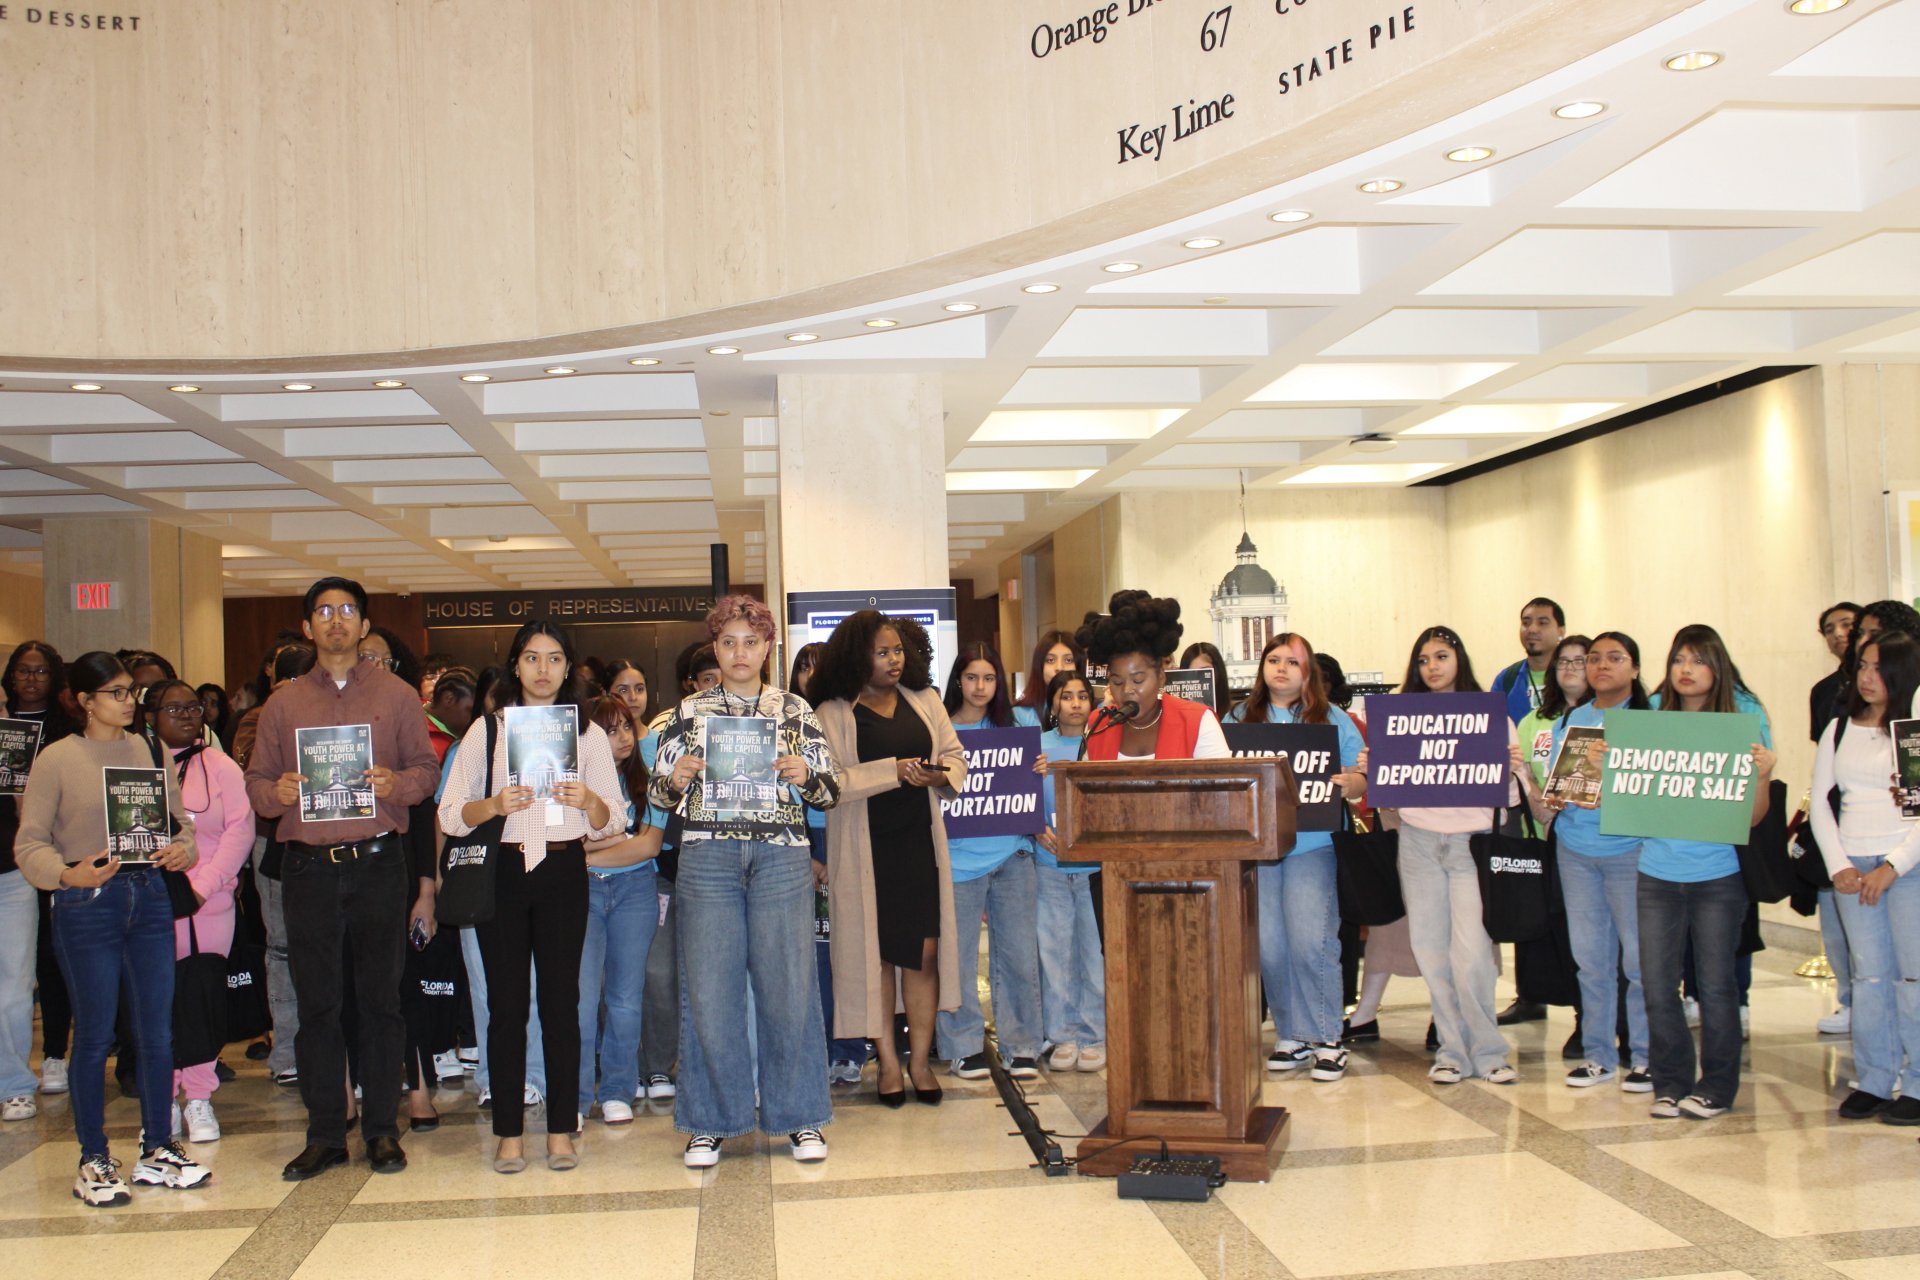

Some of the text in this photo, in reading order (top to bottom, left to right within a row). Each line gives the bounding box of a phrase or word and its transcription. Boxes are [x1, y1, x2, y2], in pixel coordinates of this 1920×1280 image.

[26, 7, 140, 31] DESSERT
[1200, 6, 1232, 52] 67
[1031, 2, 1119, 58] Orange
[1117, 6, 1415, 164] Key Lime STATE PIE
[77, 583, 111, 609] EXIT
[427, 595, 715, 618] HOUSE OF REPRESENTATIVES
[1181, 683, 1202, 691] POWER
[1181, 691, 1204, 699] CAPITOL
[563, 722, 571, 732] AT
[1387, 714, 1489, 735] EDUCATION
[2, 741, 26, 750] CAPITOL
[4, 733, 26, 743] POWER
[710, 734, 772, 745] YOUTH POWER AT
[720, 743, 763, 754] THE CAPITOL
[303, 743, 366, 756] YOUTH POWER AT
[313, 753, 358, 764] THE CAPITOL
[962, 747, 1024, 770] CATION
[1419, 739, 1459, 760] NOT
[1293, 750, 1331, 774] OFF
[1608, 747, 1754, 777] DEMOCRACY IS
[960, 772, 995, 793] NOT
[1376, 763, 1503, 786] DEPORTATION
[109, 785, 163, 796] YOUTH POWER AT
[1299, 780, 1334, 804] ED!
[1612, 771, 1749, 802] NOT FOR SALE
[117, 795, 157, 804] THE CAPITOL
[940, 793, 1038, 818] PORTATION
[459, 844, 487, 858] FLORIDA
